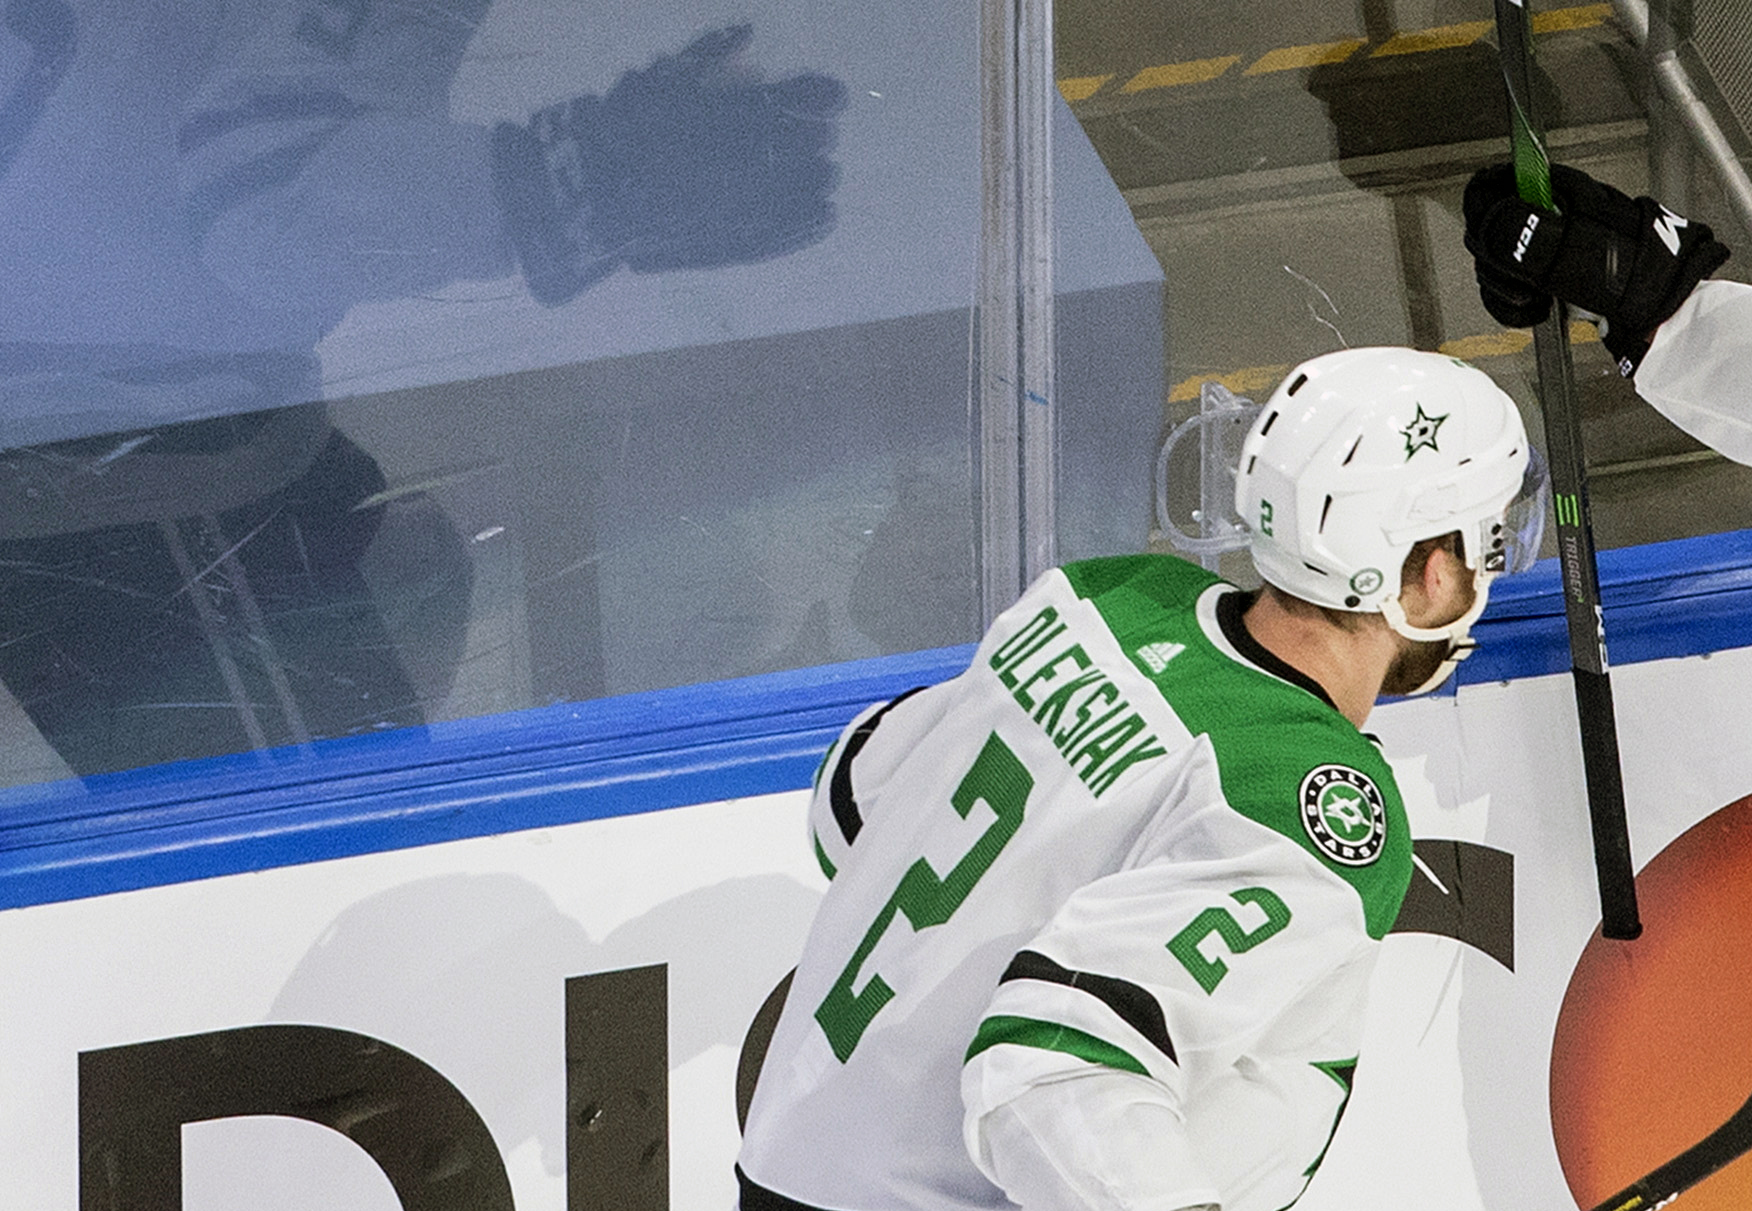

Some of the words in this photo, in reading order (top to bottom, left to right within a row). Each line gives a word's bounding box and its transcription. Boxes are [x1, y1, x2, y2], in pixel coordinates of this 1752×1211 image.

[1513, 213, 1540, 263] CCM
[989, 606, 1167, 799] OLEKSIAK
[1306, 804, 1372, 858] STARS
[1313, 770, 1386, 835] DALLAS
[814, 730, 1035, 1064] 2
[1165, 886, 1292, 996] 2
